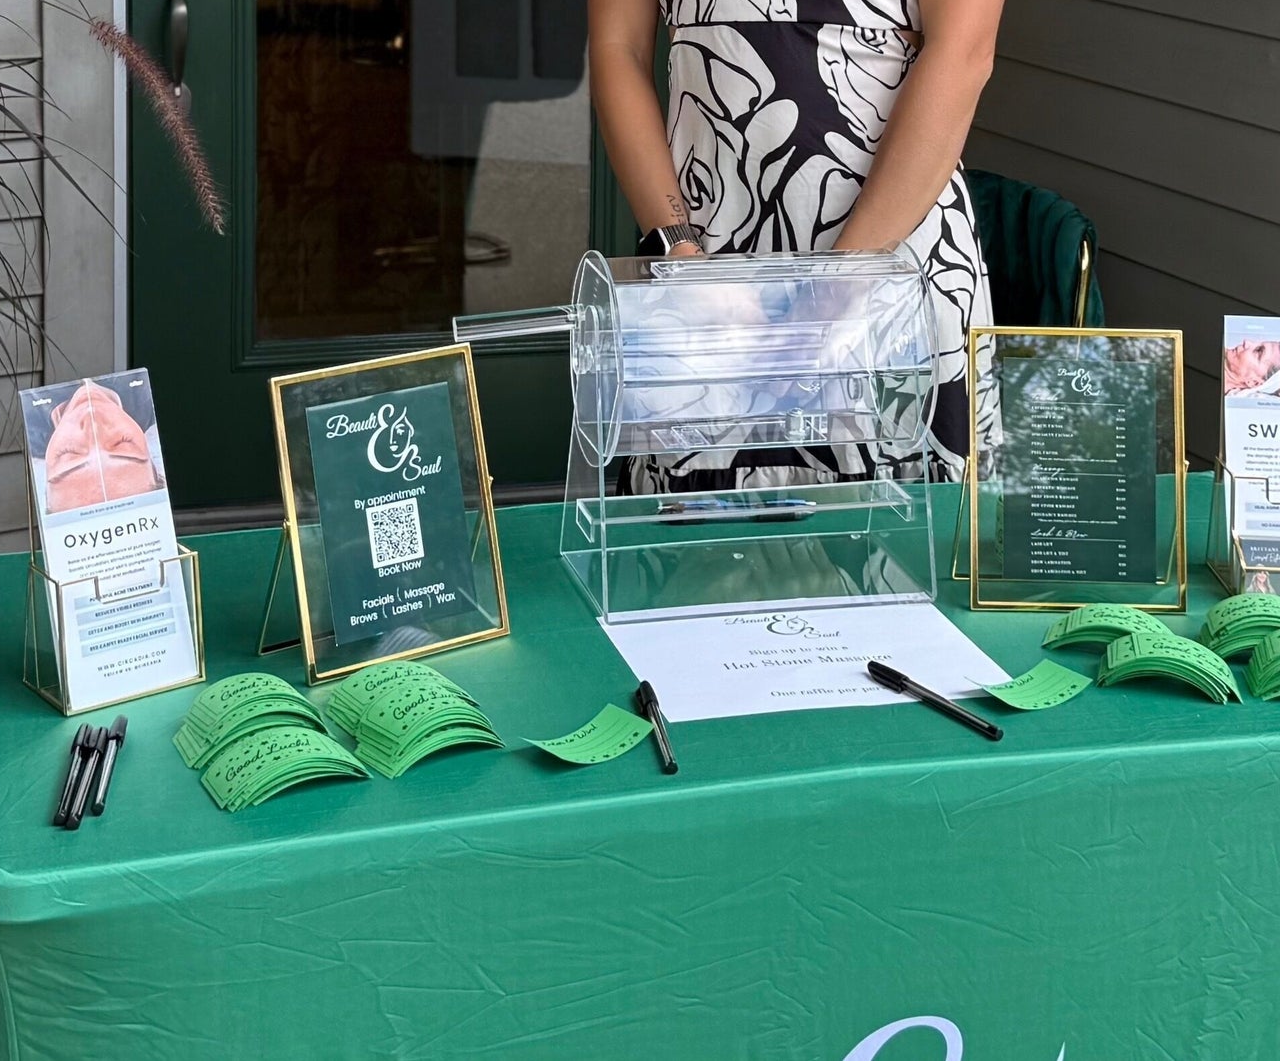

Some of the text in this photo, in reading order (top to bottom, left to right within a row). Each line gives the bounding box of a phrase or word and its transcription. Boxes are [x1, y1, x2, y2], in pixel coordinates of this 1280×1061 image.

[326, 413, 377, 438] Beauti
[403, 456, 441, 481] Soul
[354, 485, 426, 511] By appointment
[64, 517, 159, 548] OxygenRx
[378, 560, 422, 577] Book Now
[350, 592, 456, 626] Brows Lashes Wax
[363, 583, 444, 609] Facials Massage
[365, 672, 401, 691] Good
[393, 694, 429, 720] Good
[226, 749, 263, 781] Good
